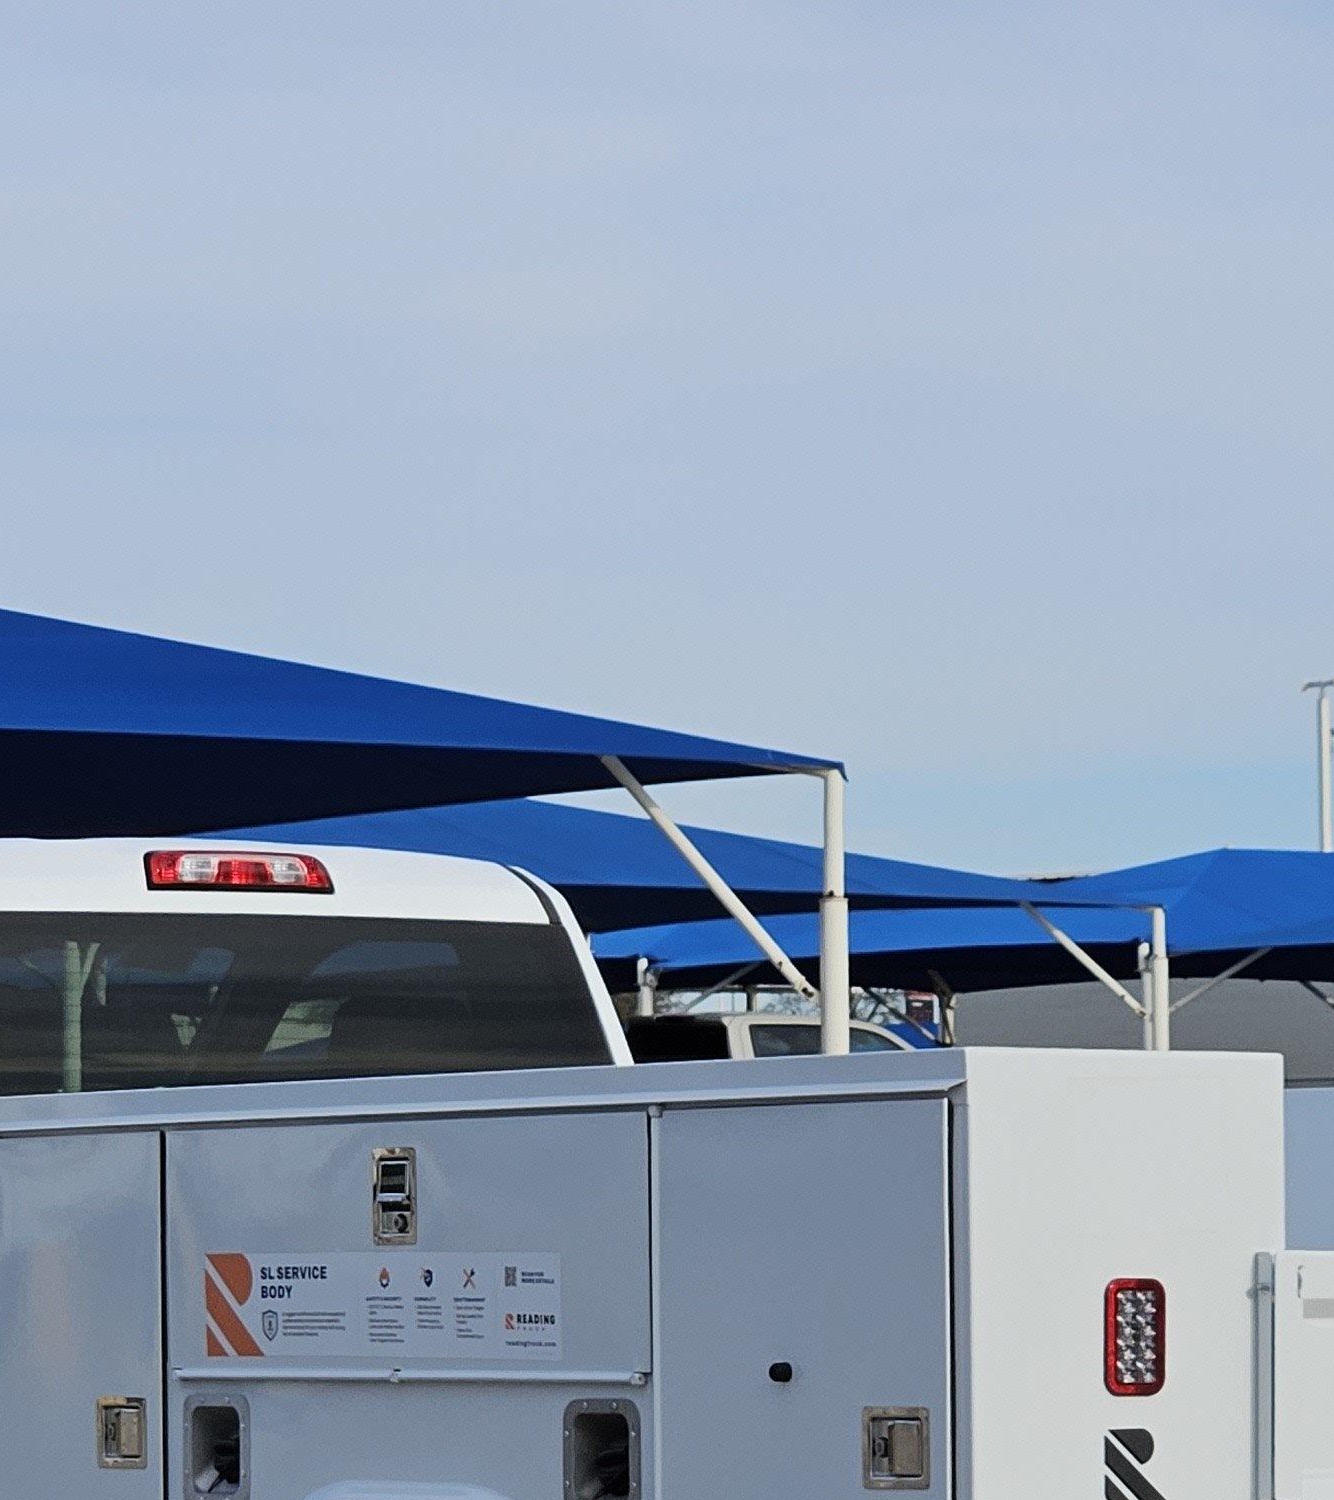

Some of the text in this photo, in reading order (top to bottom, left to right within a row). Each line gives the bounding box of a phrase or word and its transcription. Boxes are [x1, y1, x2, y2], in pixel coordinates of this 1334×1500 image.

[260, 1265, 328, 1280] SL SERVICE
[261, 1285, 293, 1299] BODY
[516, 1313, 556, 1325] READING
